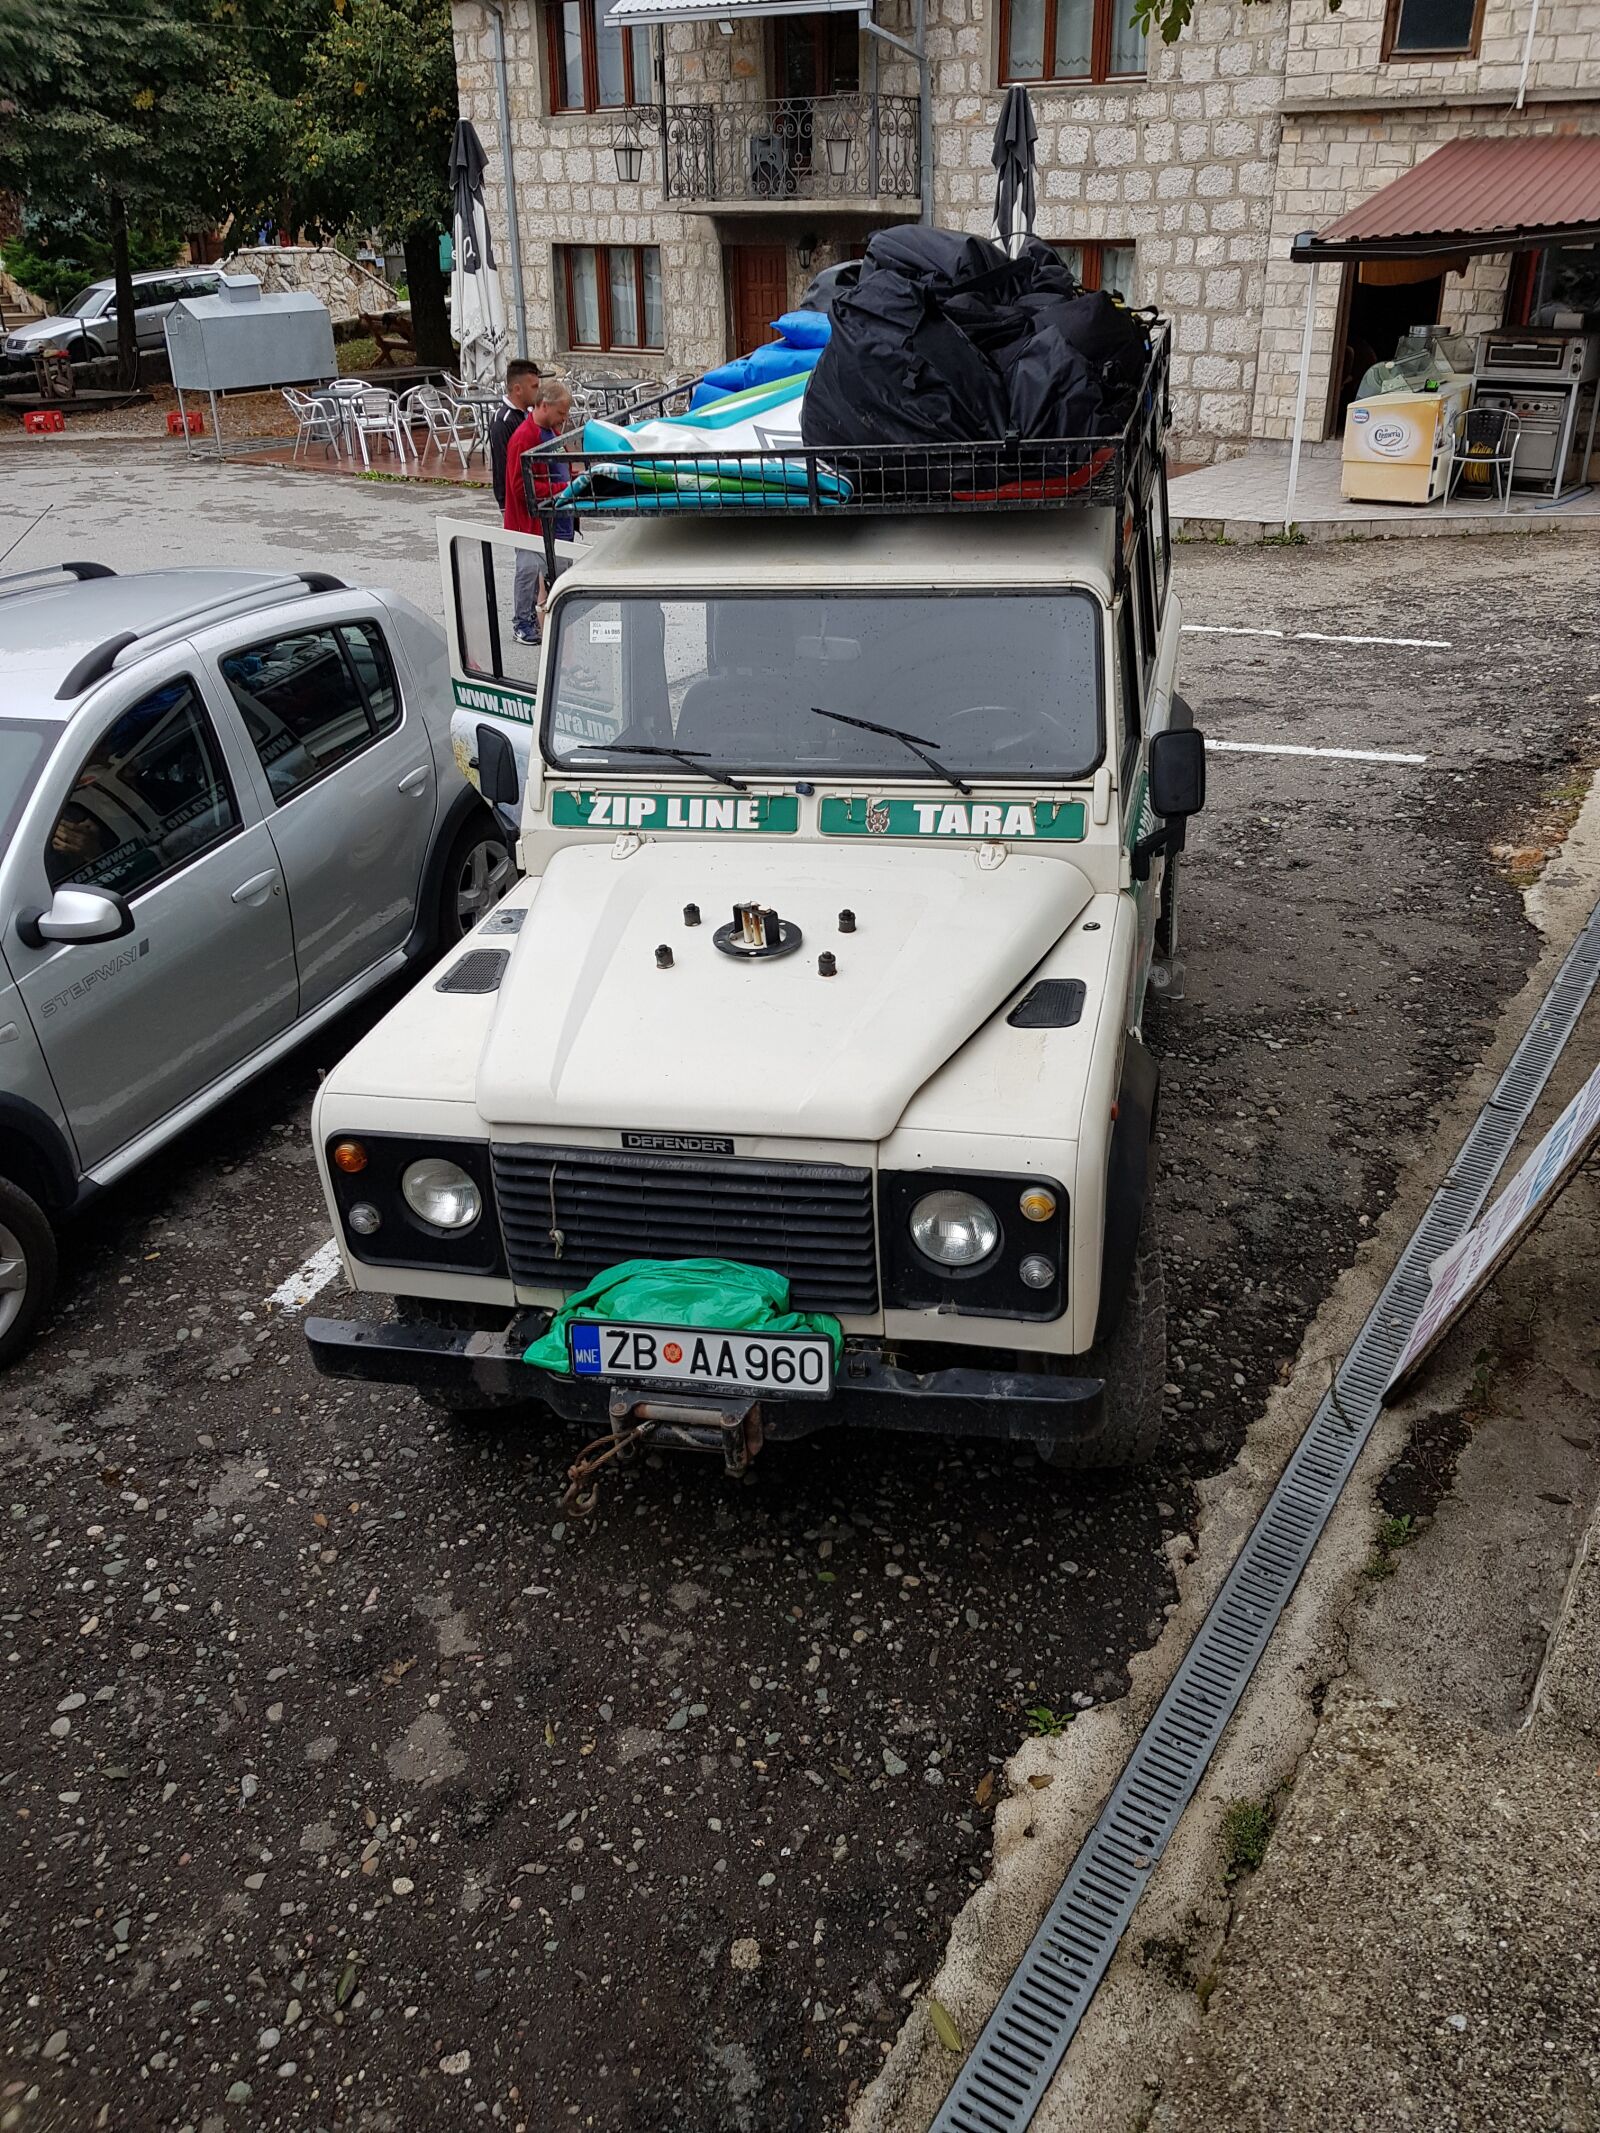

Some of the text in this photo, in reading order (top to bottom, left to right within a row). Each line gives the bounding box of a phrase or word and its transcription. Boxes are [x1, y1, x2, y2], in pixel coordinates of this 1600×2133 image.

[587, 796, 760, 829] ZIP LINE
[913, 804, 1036, 836] TARA
[40, 946, 137, 1018] STEPWAY
[627, 1135, 727, 1152] DEFENDER
[575, 1349, 599, 1364] MNE
[605, 1330, 657, 1370] ZB
